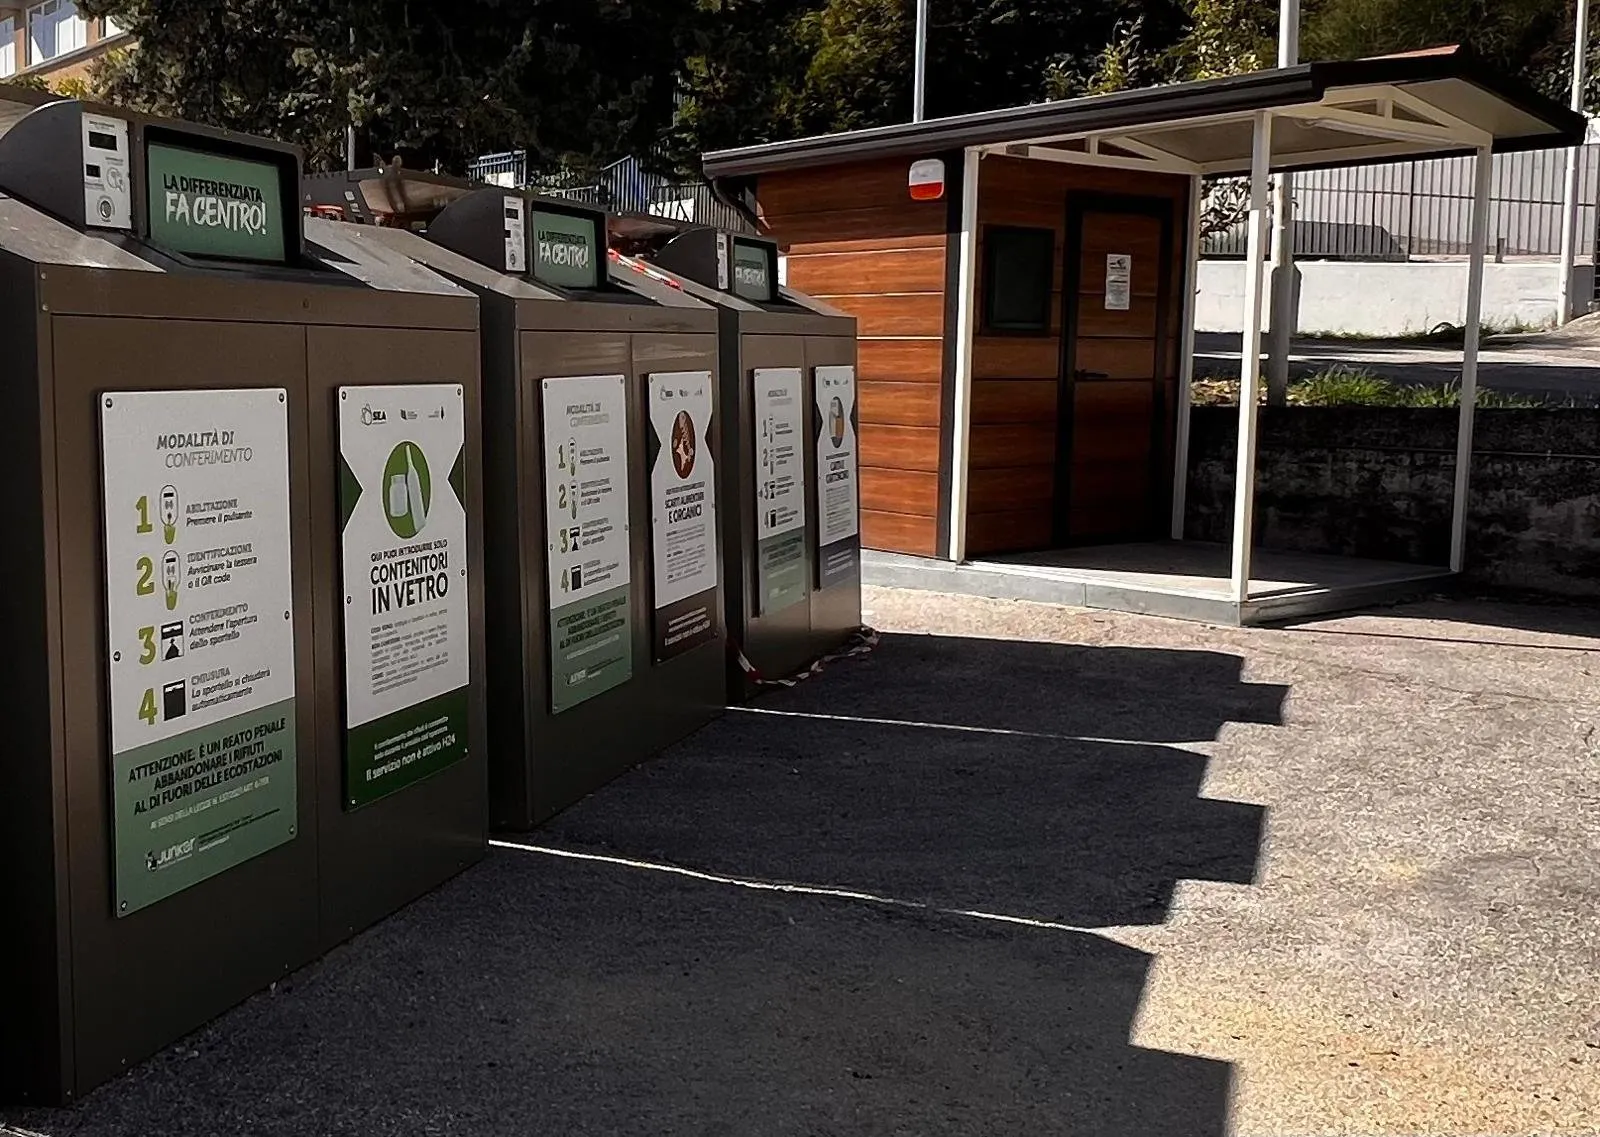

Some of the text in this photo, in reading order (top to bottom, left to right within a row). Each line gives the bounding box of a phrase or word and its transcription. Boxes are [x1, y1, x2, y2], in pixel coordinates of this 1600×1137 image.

[163, 173, 264, 202] LA DIFFERENZIATA
[165, 191, 267, 236] FA CENTRO!
[539, 242, 551, 264] FA
[156, 428, 235, 450] MODALITÀ DI
[165, 447, 253, 469] CONFERIMENTO
[558, 444, 566, 469] 1
[558, 483, 567, 509] 2
[135, 495, 153, 534] 1
[187, 543, 253, 564] IDENTIFICAZIONE
[559, 528, 568, 553] 3
[136, 556, 155, 596] 2
[213, 572, 231, 584] code
[370, 550, 448, 586] CONTENITORI
[560, 568, 569, 593] 4
[371, 571, 449, 616] IN VETRO
[189, 602, 248, 625] CONFERIMENTO
[138, 626, 156, 665] 3
[191, 667, 231, 686] CHIUSURA
[138, 687, 158, 725] 4
[207, 739, 221, 755] UN
[222, 728, 254, 751] REATO
[254, 717, 287, 740] PENALE
[154, 740, 265, 792] ABBANDONARE I RIFIUTI
[402, 752, 416, 766] non
[134, 800, 147, 816] AL
[149, 793, 161, 809] DI
[162, 782, 193, 806] FUORI
[194, 772, 224, 794] DELLE
[224, 749, 283, 782] ECOSTAZIONI
